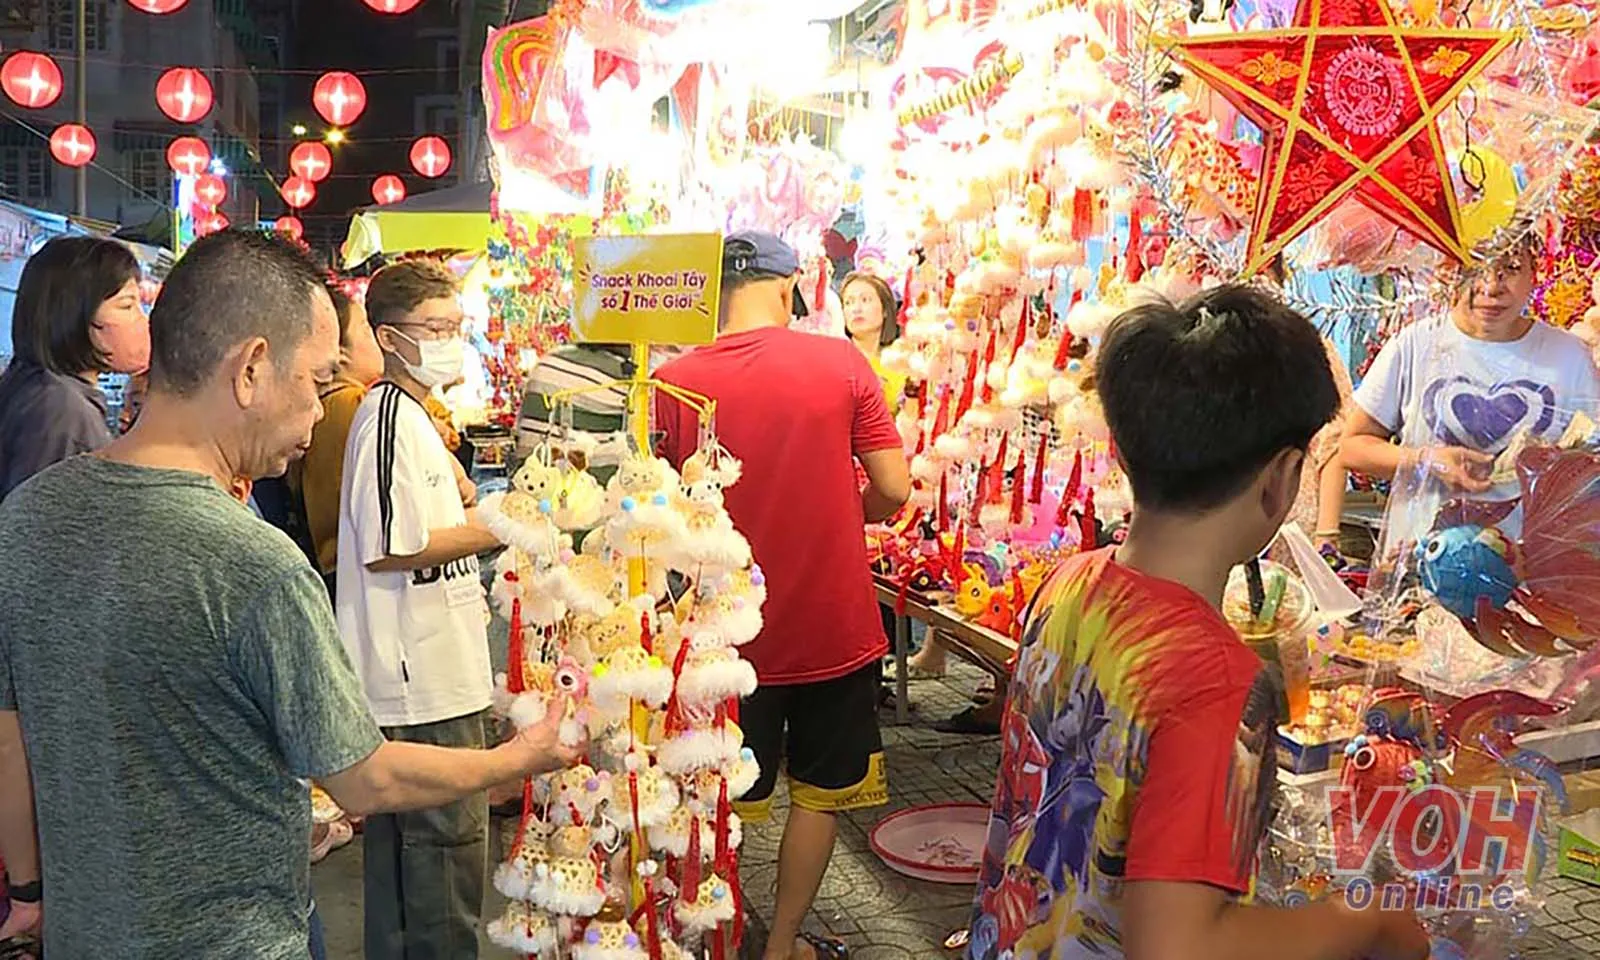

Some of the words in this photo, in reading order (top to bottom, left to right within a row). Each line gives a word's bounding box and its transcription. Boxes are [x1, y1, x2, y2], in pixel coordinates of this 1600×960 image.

[592, 273, 632, 288] Snack
[637, 272, 678, 288] Khoai
[682, 271, 707, 289] Tây
[601, 292, 618, 309] số
[619, 289, 631, 312] 1
[633, 293, 658, 309] Thế
